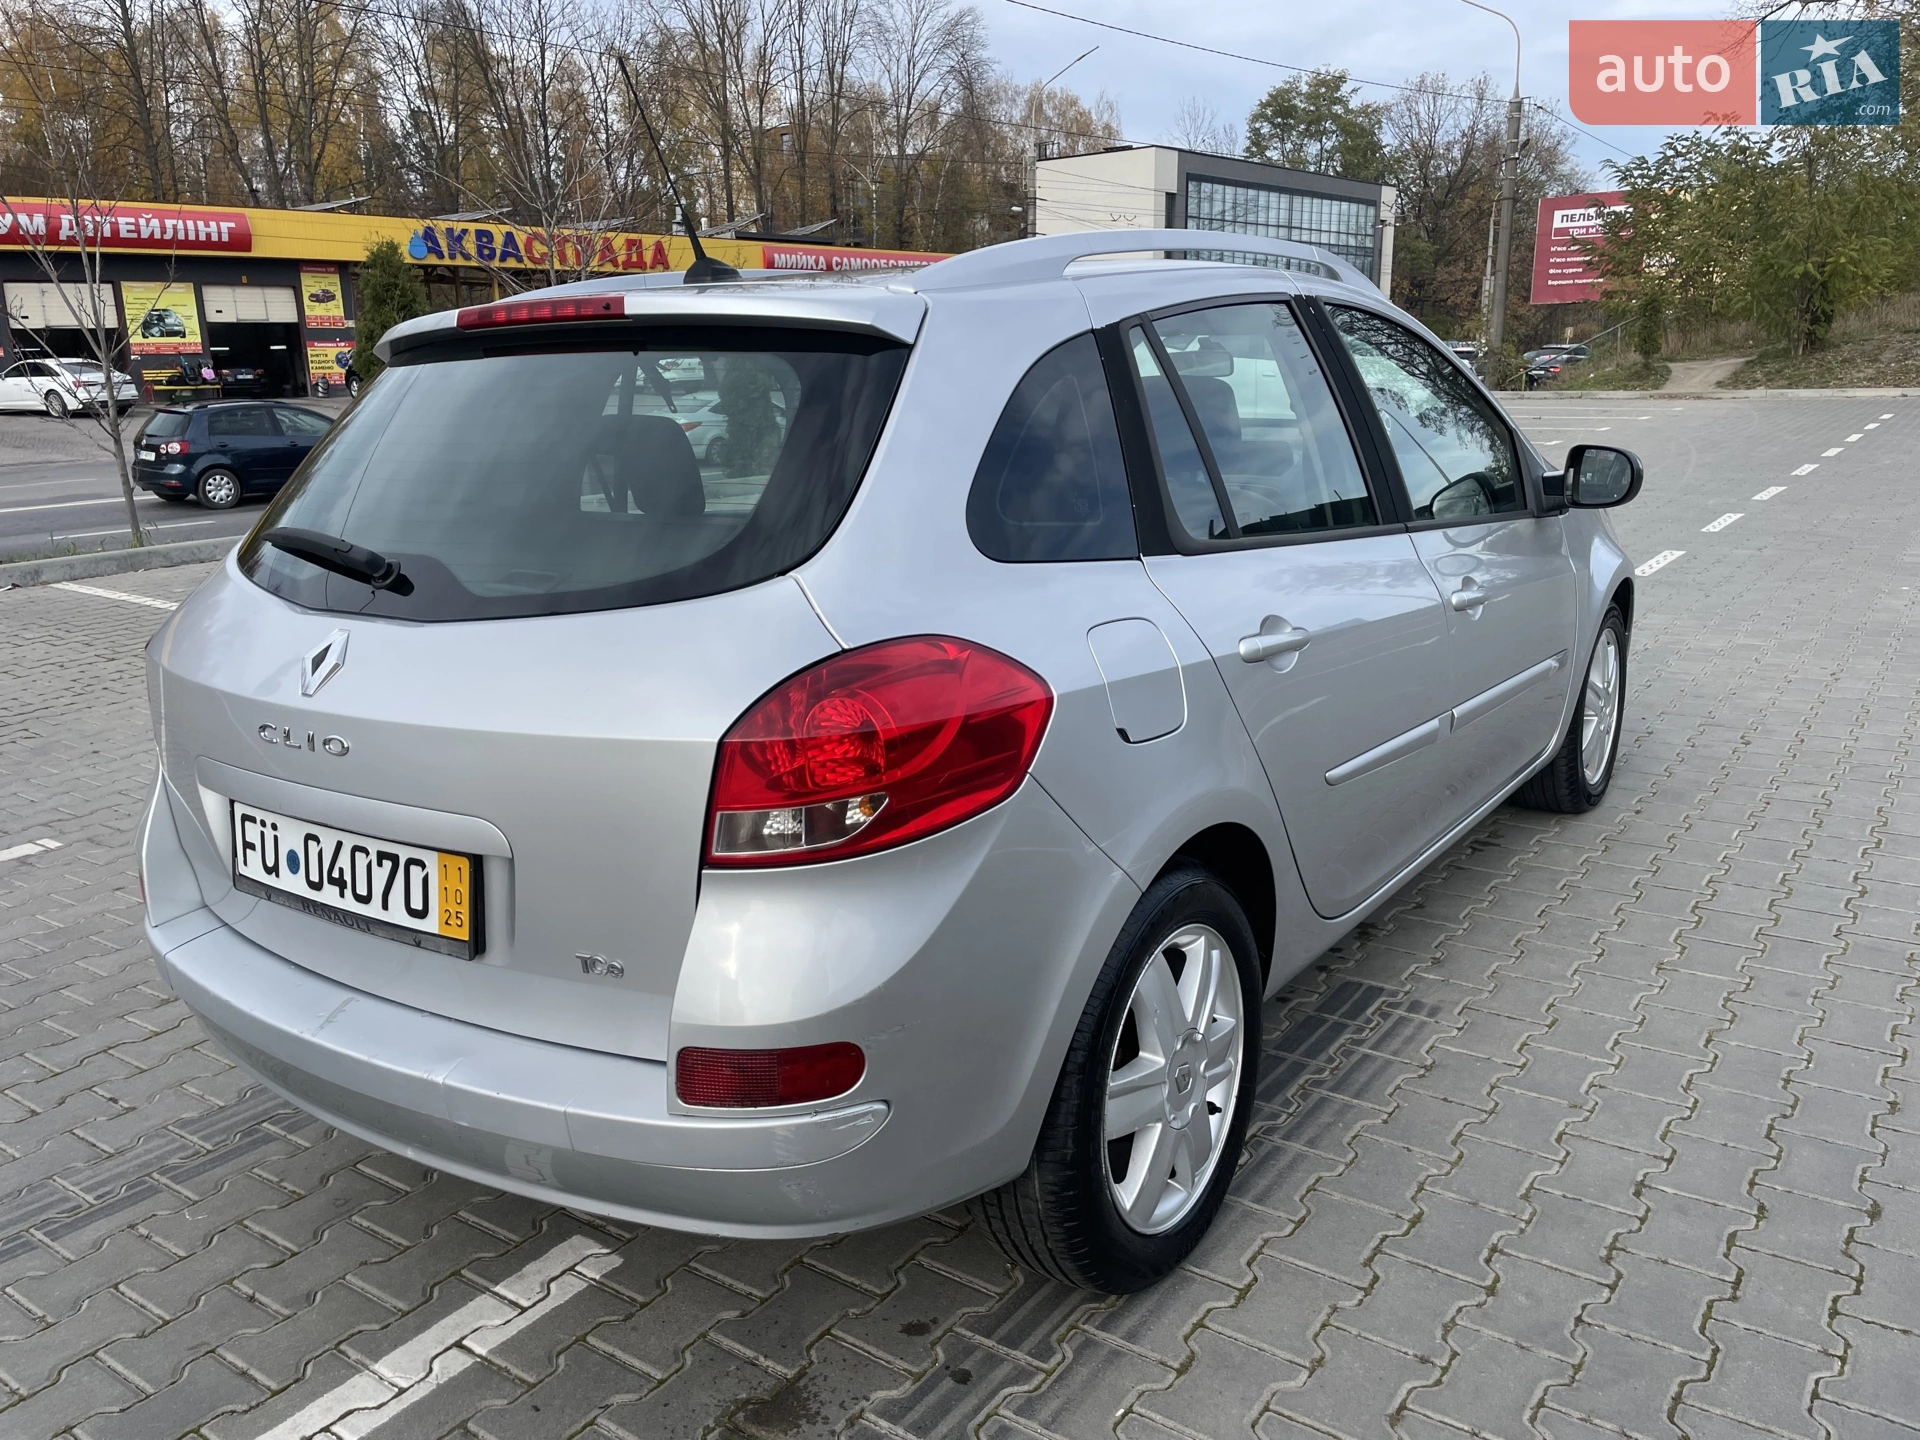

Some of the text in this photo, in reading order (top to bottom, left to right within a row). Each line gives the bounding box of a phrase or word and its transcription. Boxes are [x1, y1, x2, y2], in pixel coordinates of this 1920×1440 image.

[59, 212, 236, 242] ДІТЕЙЛІНГ
[1568, 228, 1586, 236] три
[420, 226, 671, 271] АКВАСТРАДА
[773, 251, 827, 270] МИЙКА
[257, 722, 351, 757] CLIO
[240, 812, 430, 920] FÜ 04070
[302, 902, 372, 933] RENAULT
[443, 909, 464, 928] 25
[575, 952, 625, 979] TCe
